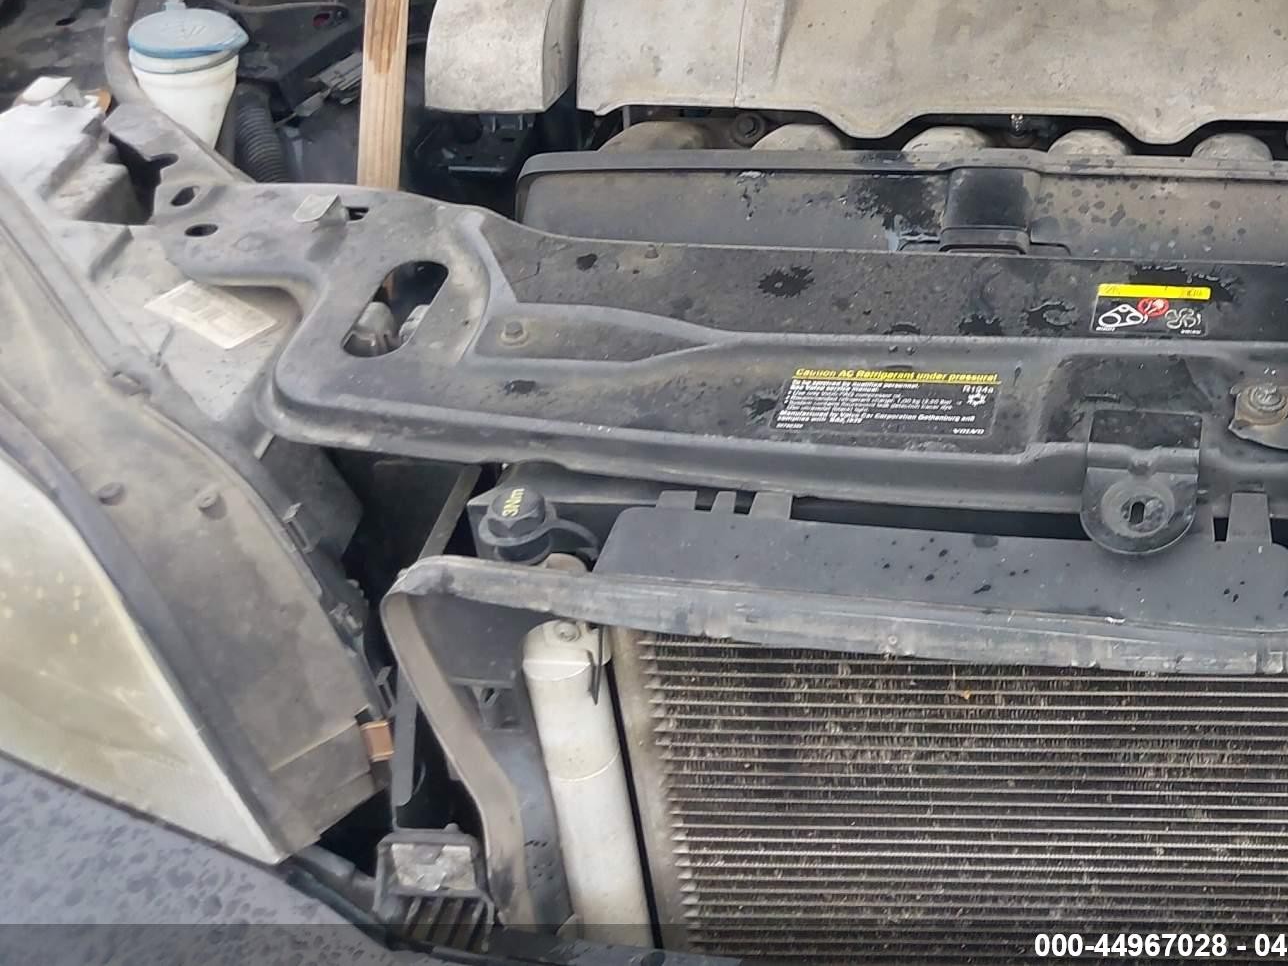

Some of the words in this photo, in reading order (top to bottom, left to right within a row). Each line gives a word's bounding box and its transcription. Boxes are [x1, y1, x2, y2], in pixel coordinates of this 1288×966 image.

[795, 368, 837, 378] Caution
[838, 369, 855, 378] AC
[855, 370, 915, 380] Refrigerant
[916, 371, 947, 381] under
[948, 373, 998, 383] pressure!
[501, 488, 526, 517] 3Nm
